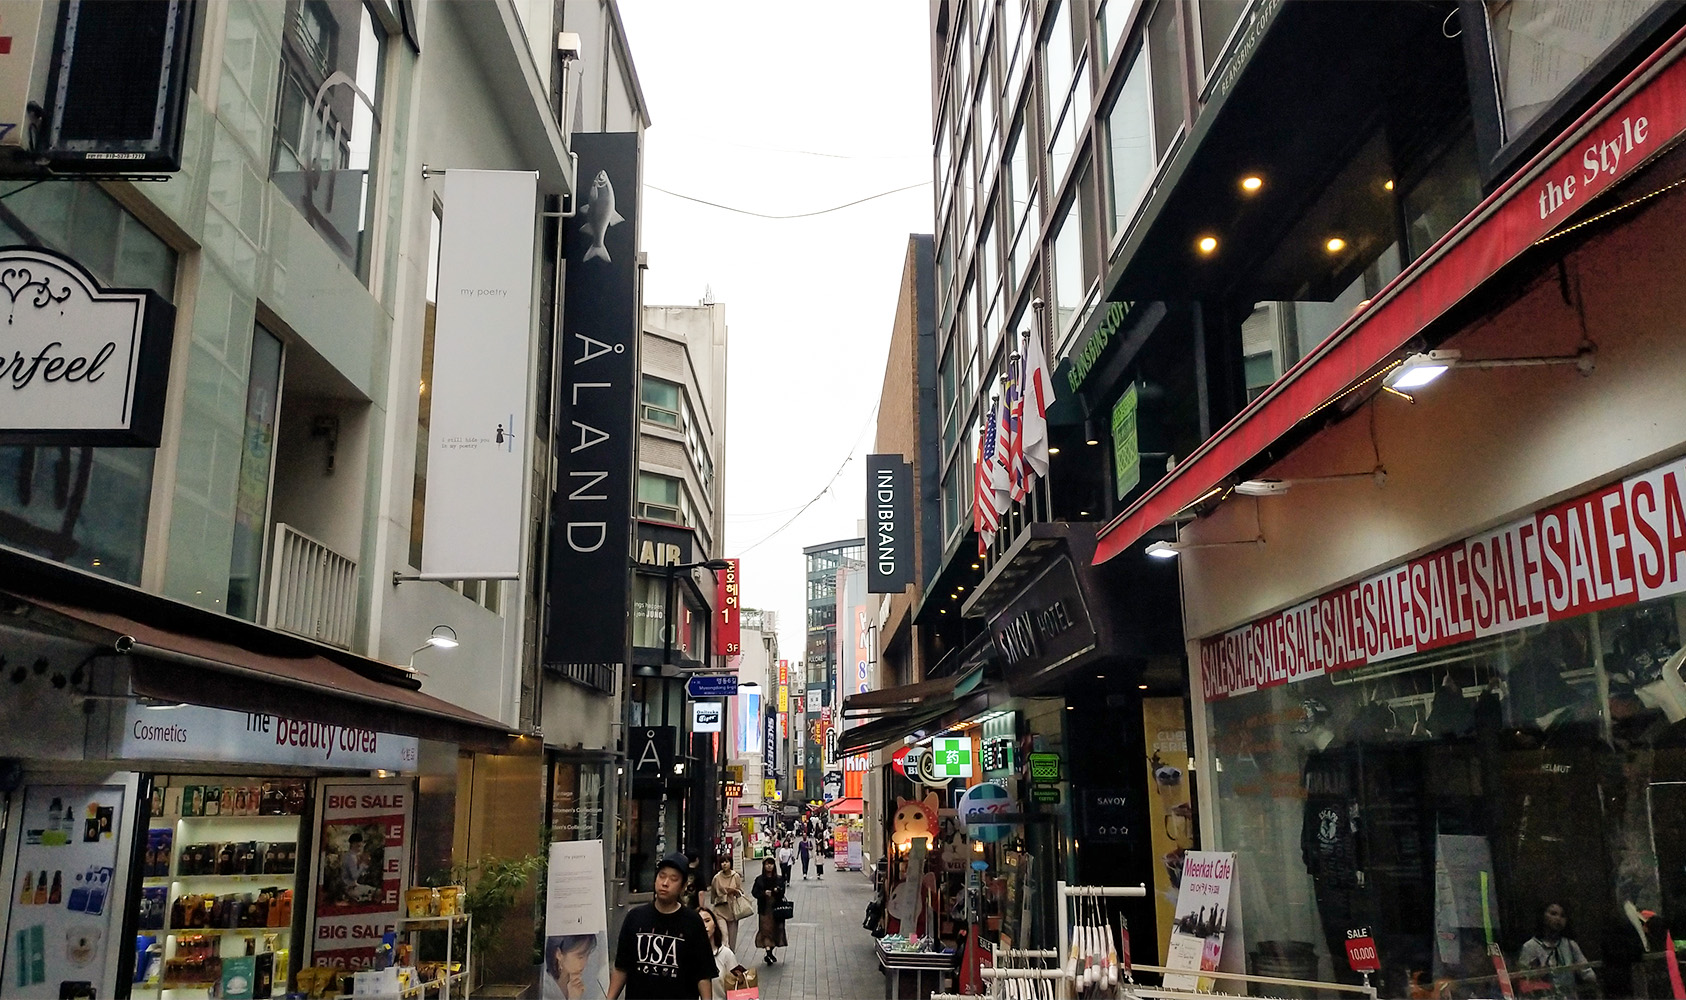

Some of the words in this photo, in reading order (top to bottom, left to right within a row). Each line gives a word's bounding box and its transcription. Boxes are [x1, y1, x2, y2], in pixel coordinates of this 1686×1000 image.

[1221, 31, 1256, 96] BEANSBINS
[1539, 175, 1576, 220] the
[1583, 116, 1649, 187] Style
[460, 288, 474, 297] my
[477, 288, 508, 298] poetry
[566, 333, 625, 553] ÅLAND
[877, 470, 895, 576] INDIBRAND
[636, 539, 681, 567] AIR
[1202, 639, 1229, 698] SALE
[1226, 630, 1255, 692] SALE
[1253, 618, 1287, 686] SALE
[1285, 604, 1323, 678] SALE
[1321, 589, 1365, 668] SALE
[1363, 568, 1414, 657] SALE
[1411, 549, 1473, 645] SALE
[1470, 523, 1544, 630] SALE
[1541, 491, 1634, 612] SALE
[721, 608, 729, 624] 1
[999, 611, 1038, 665] SAVOY
[1036, 601, 1074, 641] HOTEL
[726, 643, 739, 652] 3F
[133, 720, 187, 743] Cosmetics
[275, 716, 336, 760] beauty
[767, 716, 775, 777] SKECHERS
[945, 749, 960, 765] 药
[846, 754, 869, 772] Kin
[328, 795, 357, 809] BIG
[361, 795, 404, 809] SALE
[1097, 797, 1126, 806] SAVOY
[1184, 858, 1214, 879] Meerkat
[1214, 859, 1231, 880] Cafe
[318, 925, 347, 939] BIG
[1346, 928, 1369, 939] SALE
[636, 933, 679, 967] USA
[1350, 946, 1375, 961] 10,000
